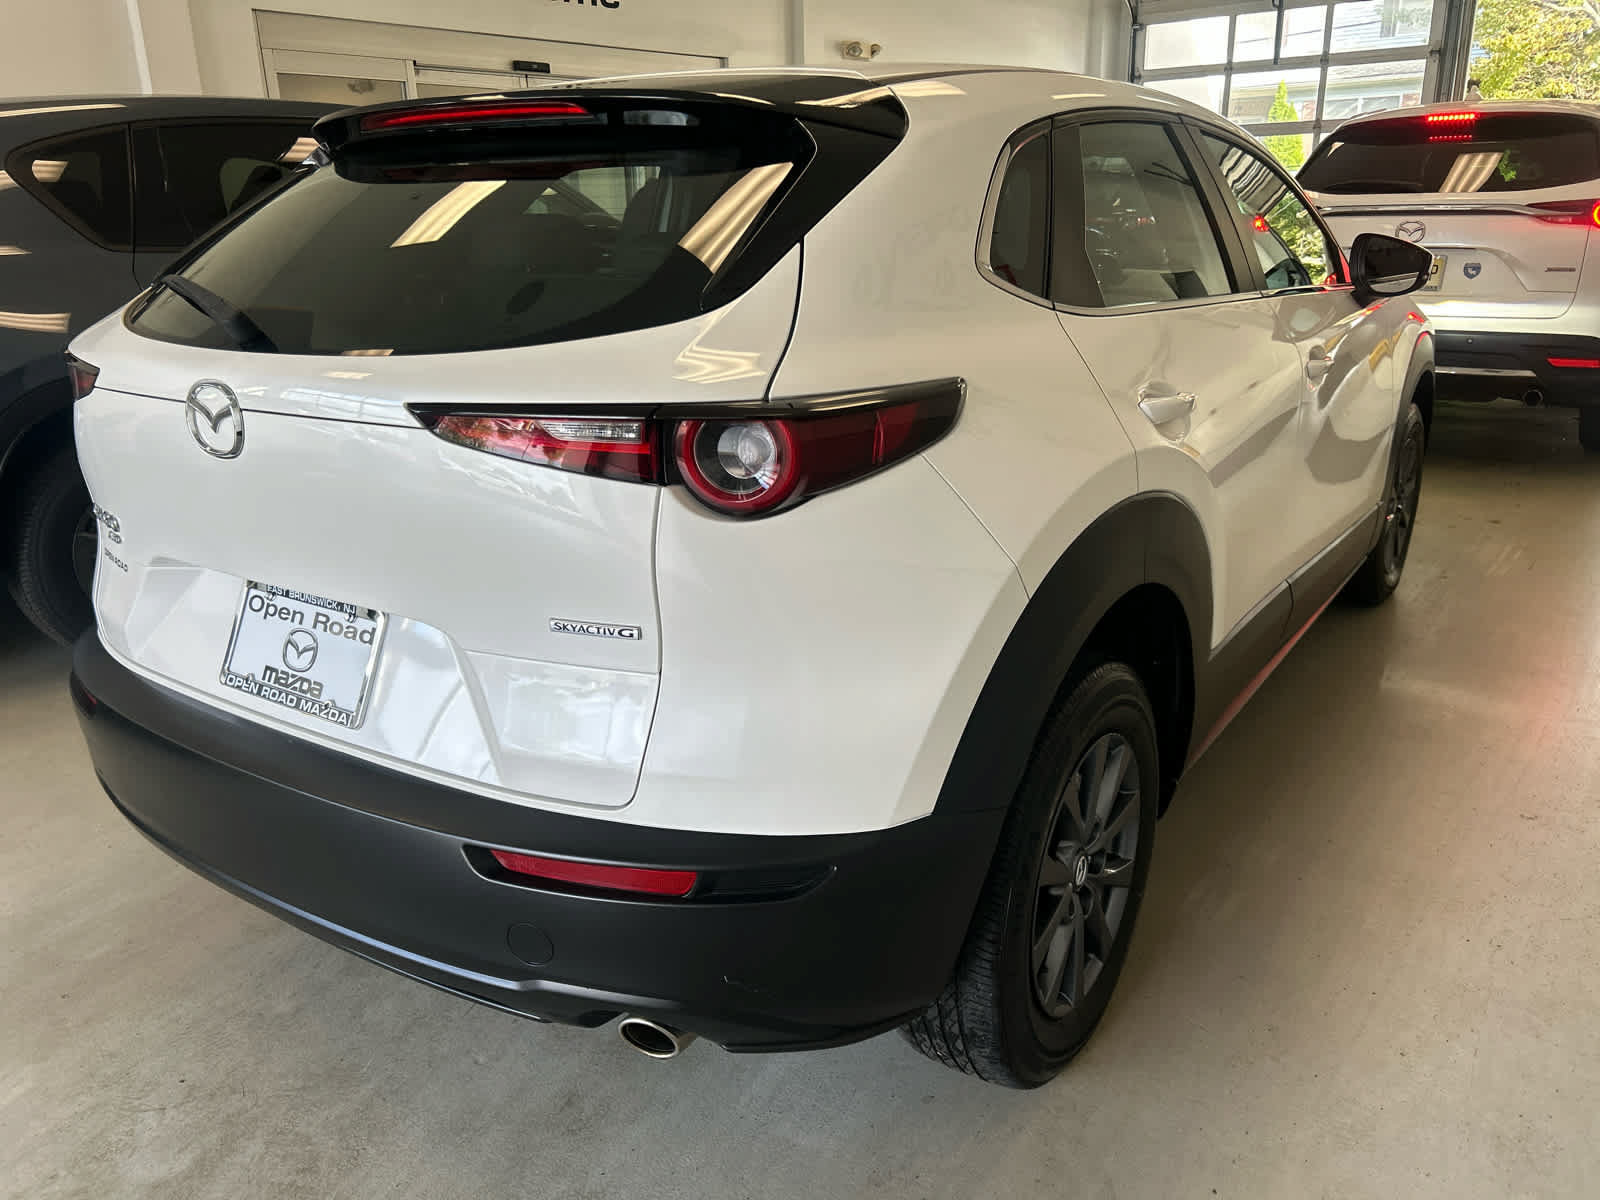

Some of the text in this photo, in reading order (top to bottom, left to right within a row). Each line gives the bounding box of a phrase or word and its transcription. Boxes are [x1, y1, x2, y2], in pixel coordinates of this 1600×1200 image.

[248, 594, 376, 646] Open Road
[266, 584, 287, 596] EAST
[343, 604, 357, 614] NJ
[226, 674, 349, 726] OPEN ROAD MAZDA
[261, 664, 324, 700] mazda
